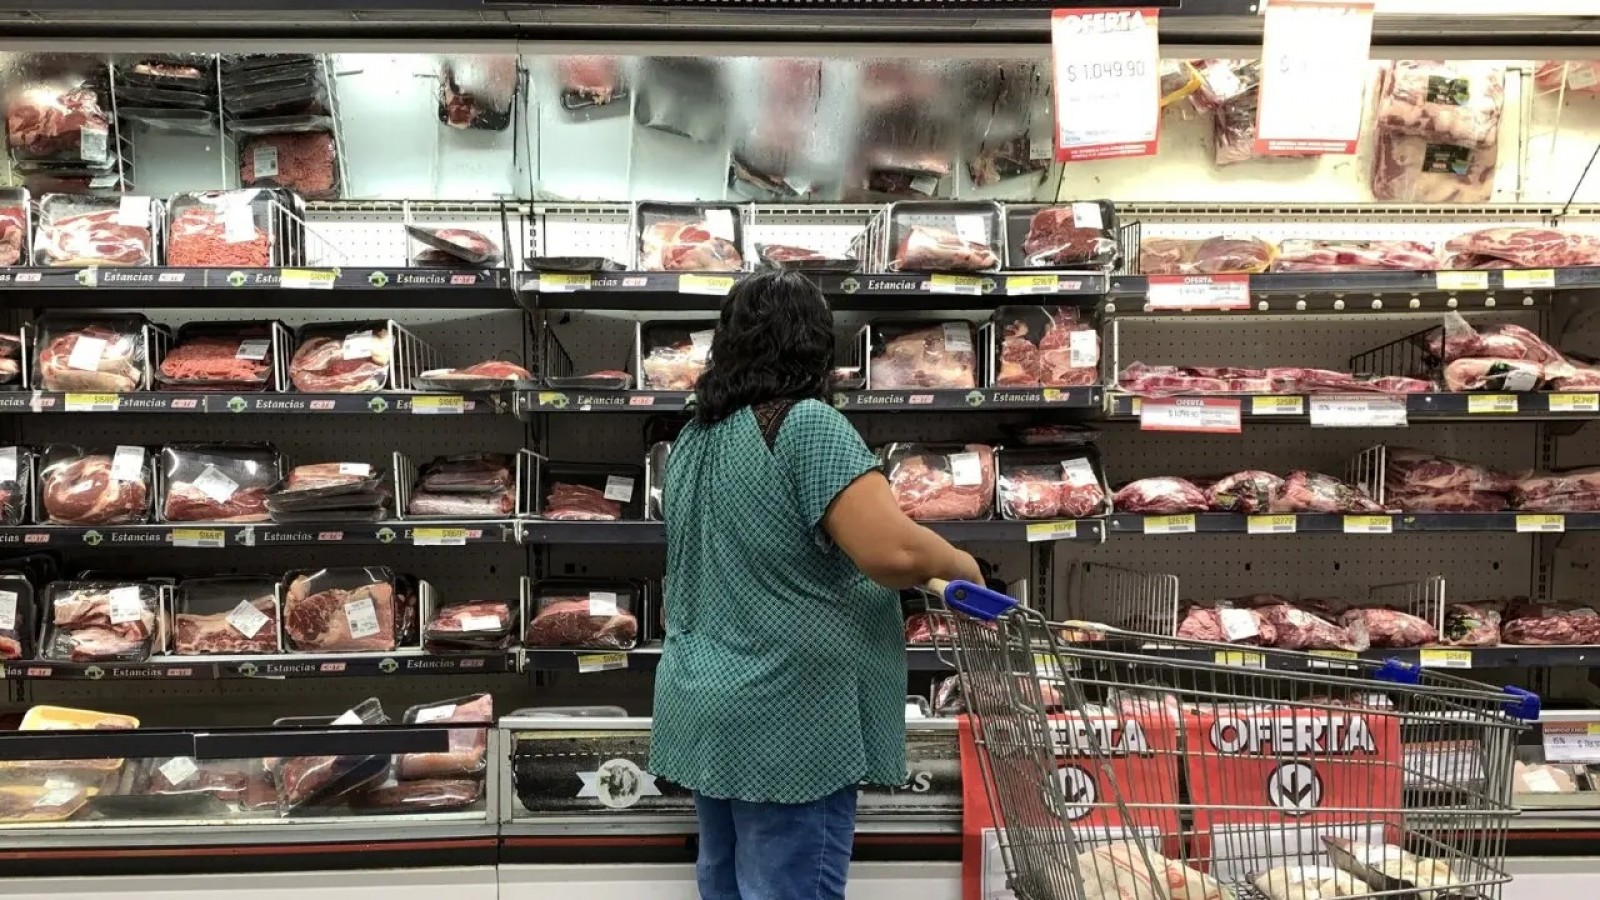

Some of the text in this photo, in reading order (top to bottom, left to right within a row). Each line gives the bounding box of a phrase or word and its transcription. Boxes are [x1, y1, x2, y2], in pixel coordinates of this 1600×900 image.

[1063, 10, 1145, 33] OFERTA
[1067, 60, 1146, 82] $ 1.04990
[104, 273, 154, 282] Estancias
[397, 274, 446, 284] Estancias
[1184, 277, 1213, 285] OFERTA
[868, 280, 916, 290] Estancias
[577, 395, 625, 405] Estancias
[856, 395, 904, 404] Estancias
[993, 393, 1040, 402] Estancias
[119, 398, 166, 408] Estancias
[256, 400, 305, 409] Estancias
[1176, 399, 1205, 407] OFERTA
[111, 532, 160, 542] Estancias
[264, 531, 313, 541] Estancias
[267, 663, 315, 673] Estancias
[407, 659, 455, 669] Estancias
[113, 667, 162, 677] Estancias
[1210, 716, 1376, 755] OFERTA
